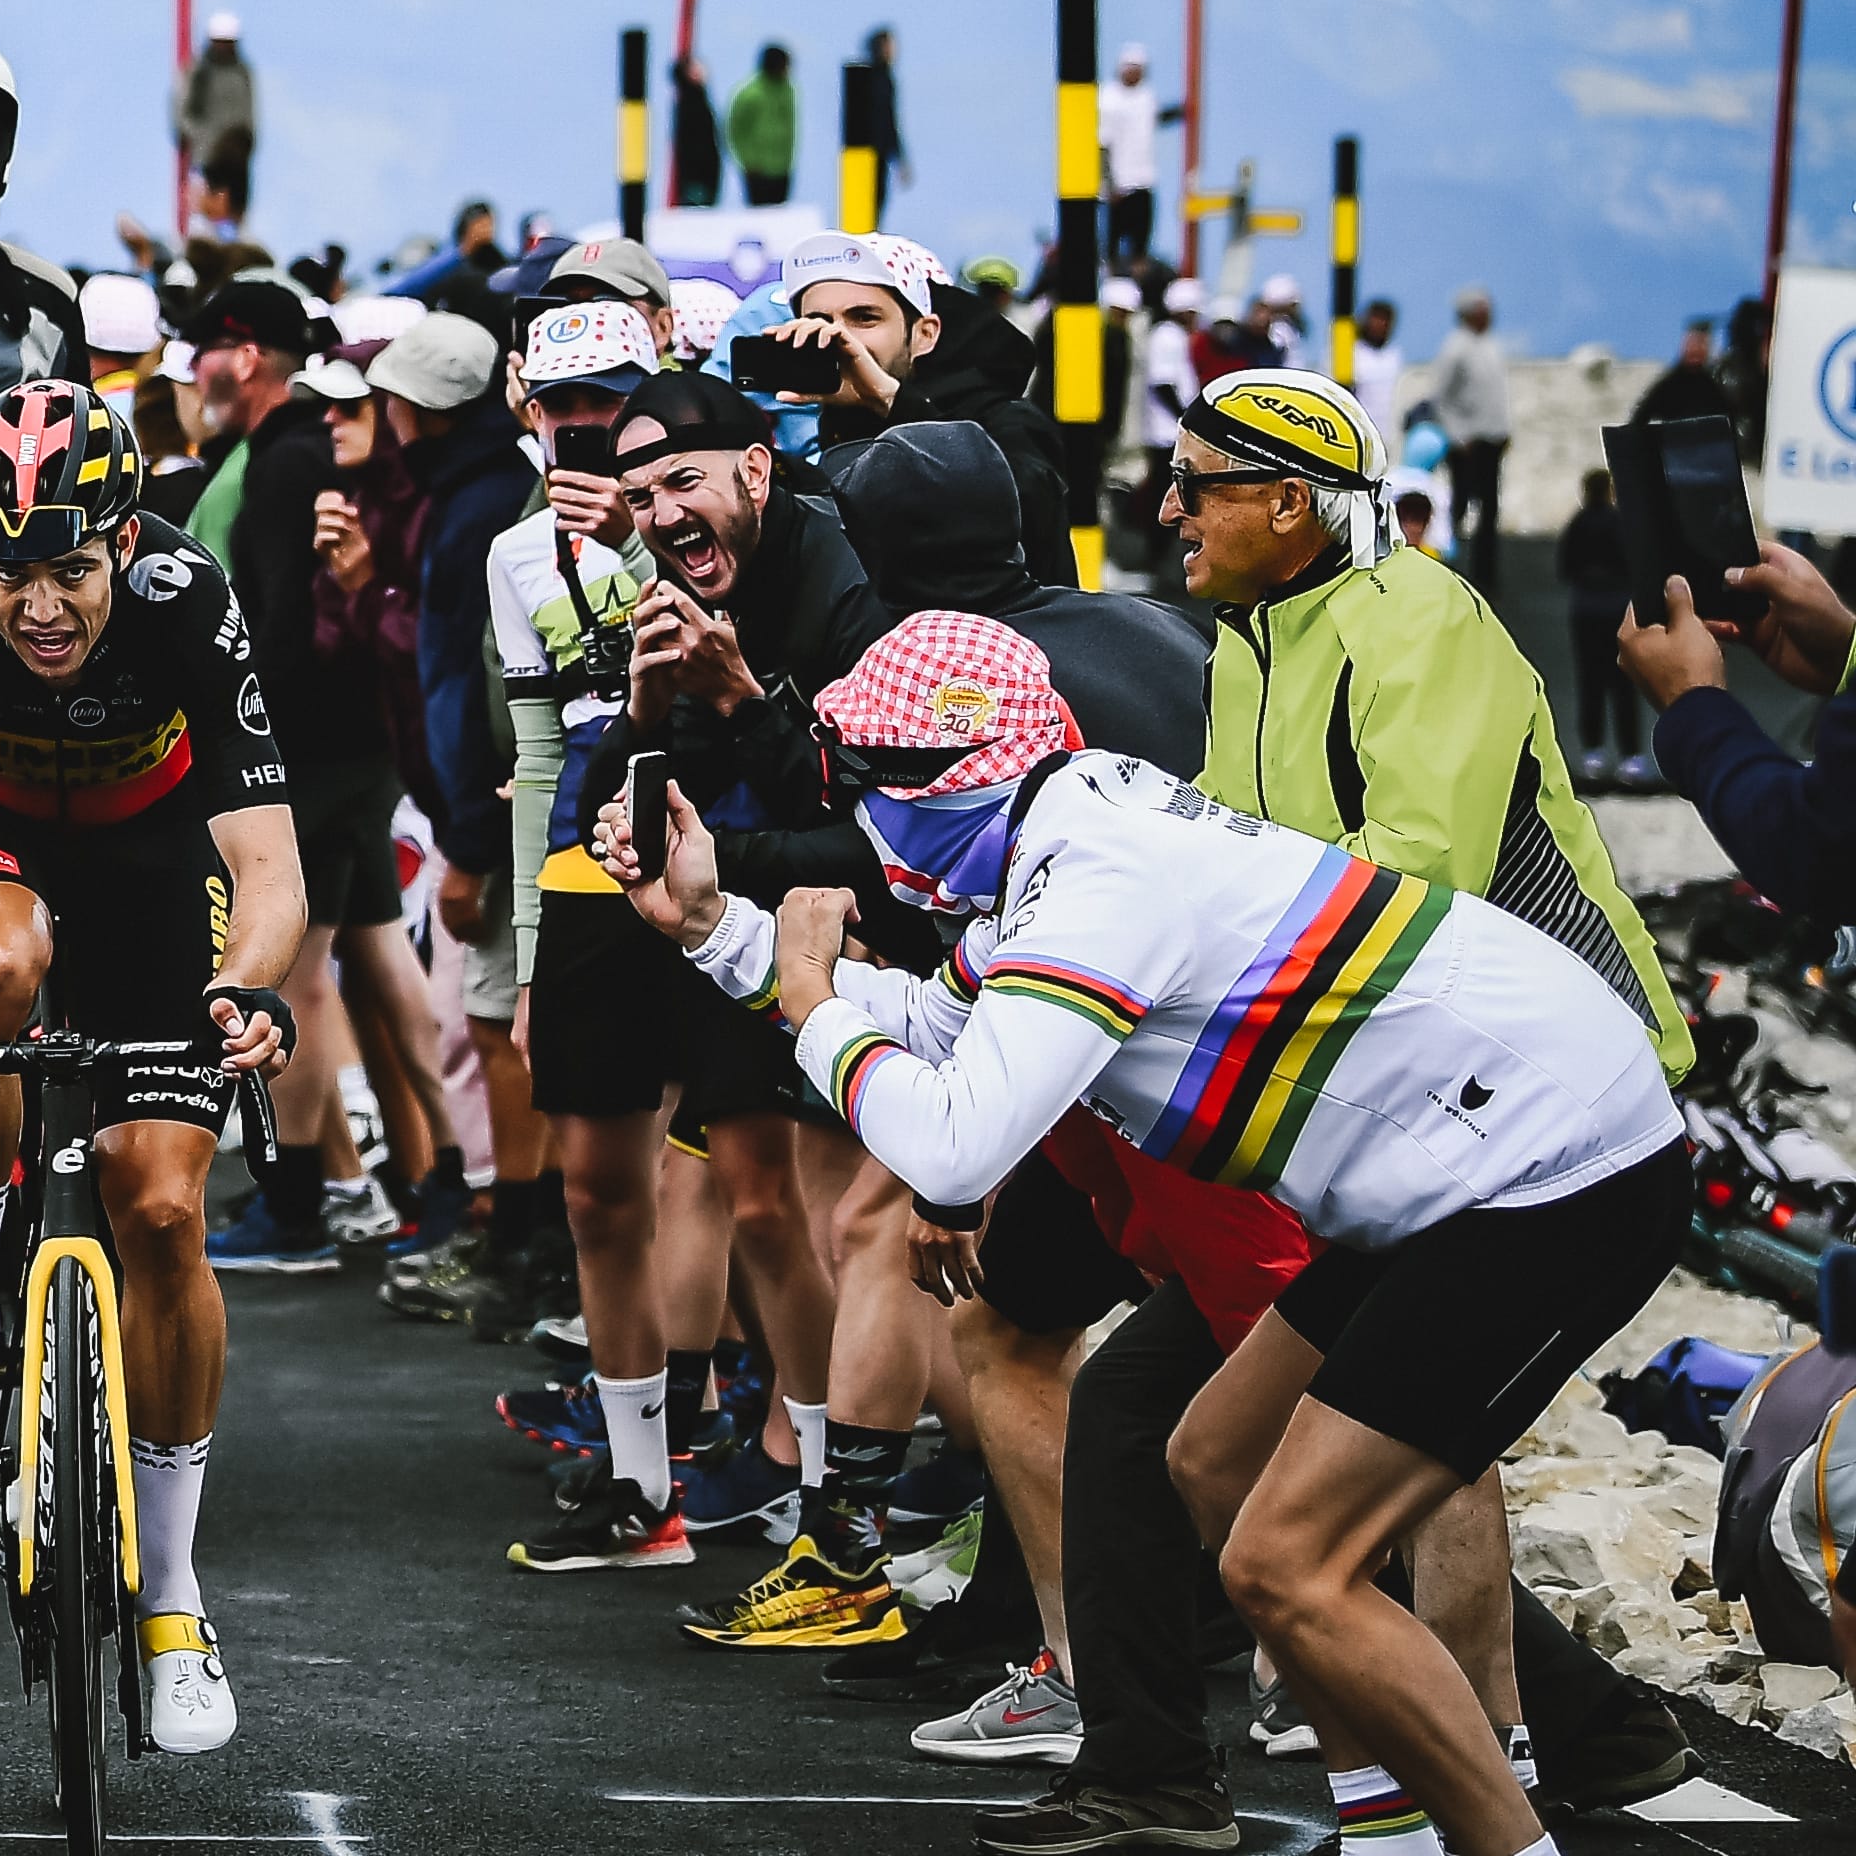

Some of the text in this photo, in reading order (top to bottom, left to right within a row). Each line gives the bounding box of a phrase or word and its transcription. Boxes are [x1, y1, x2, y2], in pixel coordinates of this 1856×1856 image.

[18, 433, 38, 466] WOUT
[241, 763, 286, 788] HE
[127, 1091, 219, 1113] cervélo
[1426, 1090, 1443, 1105] THE
